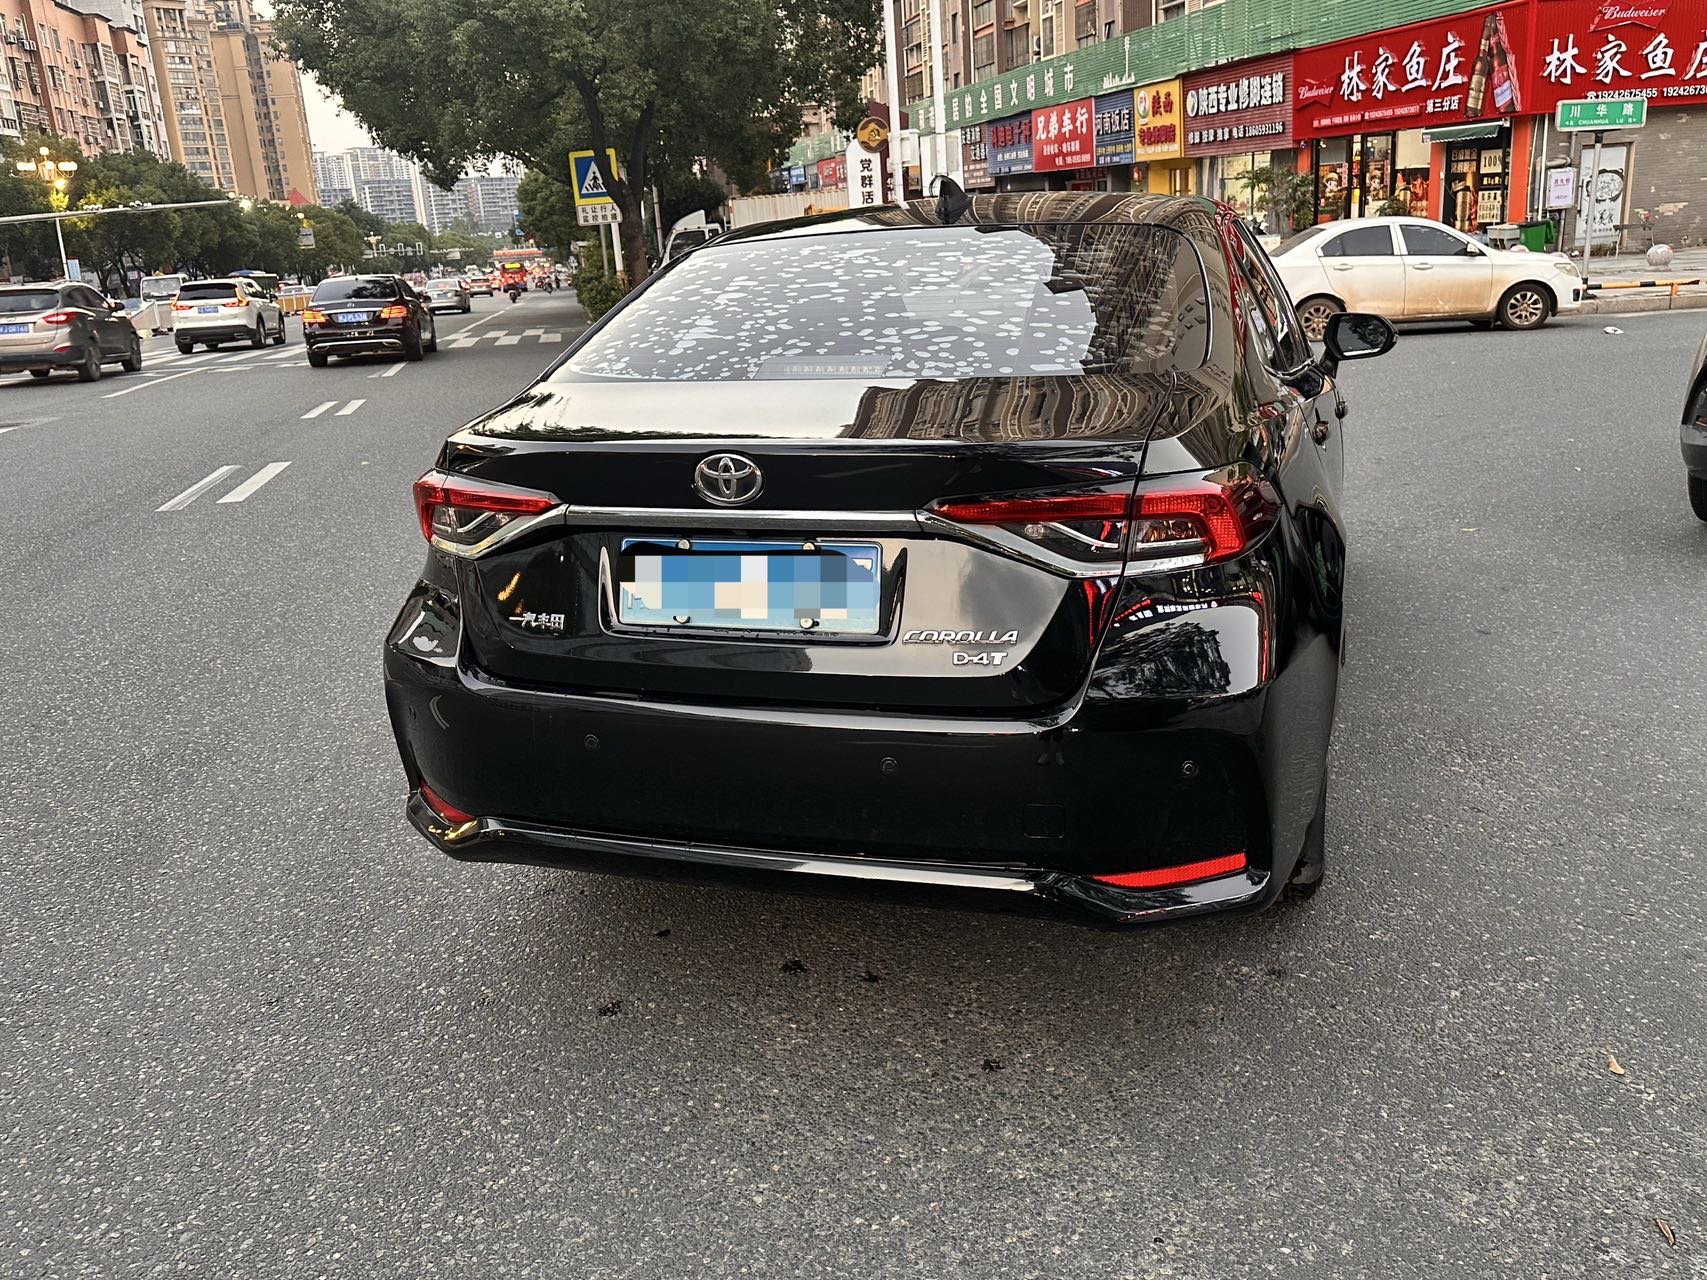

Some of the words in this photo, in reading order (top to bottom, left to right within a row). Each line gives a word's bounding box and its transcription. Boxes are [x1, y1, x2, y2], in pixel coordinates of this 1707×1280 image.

[1602, 6, 1666, 20] Budweiser
[1340, 32, 1464, 102] 林家鱼庄
[1198, 72, 1284, 116] 陕西专业修脚连锁
[1297, 84, 1334, 100] Budweiser
[1597, 87, 1658, 101] 19242675455
[1425, 97, 1460, 113] 第三分店
[1569, 103, 1634, 118] 川华路
[1036, 106, 1089, 140] 兄弟车行
[1095, 107, 1130, 135] 河南饭店
[1578, 118, 1609, 126] CHUANHUA
[860, 158, 874, 205] 党群活
[581, 204, 617, 215] 礼让行人
[582, 213, 618, 223] 监控拍摄
[902, 630, 1019, 645] COROLLA
[952, 651, 1008, 666] D-4T
